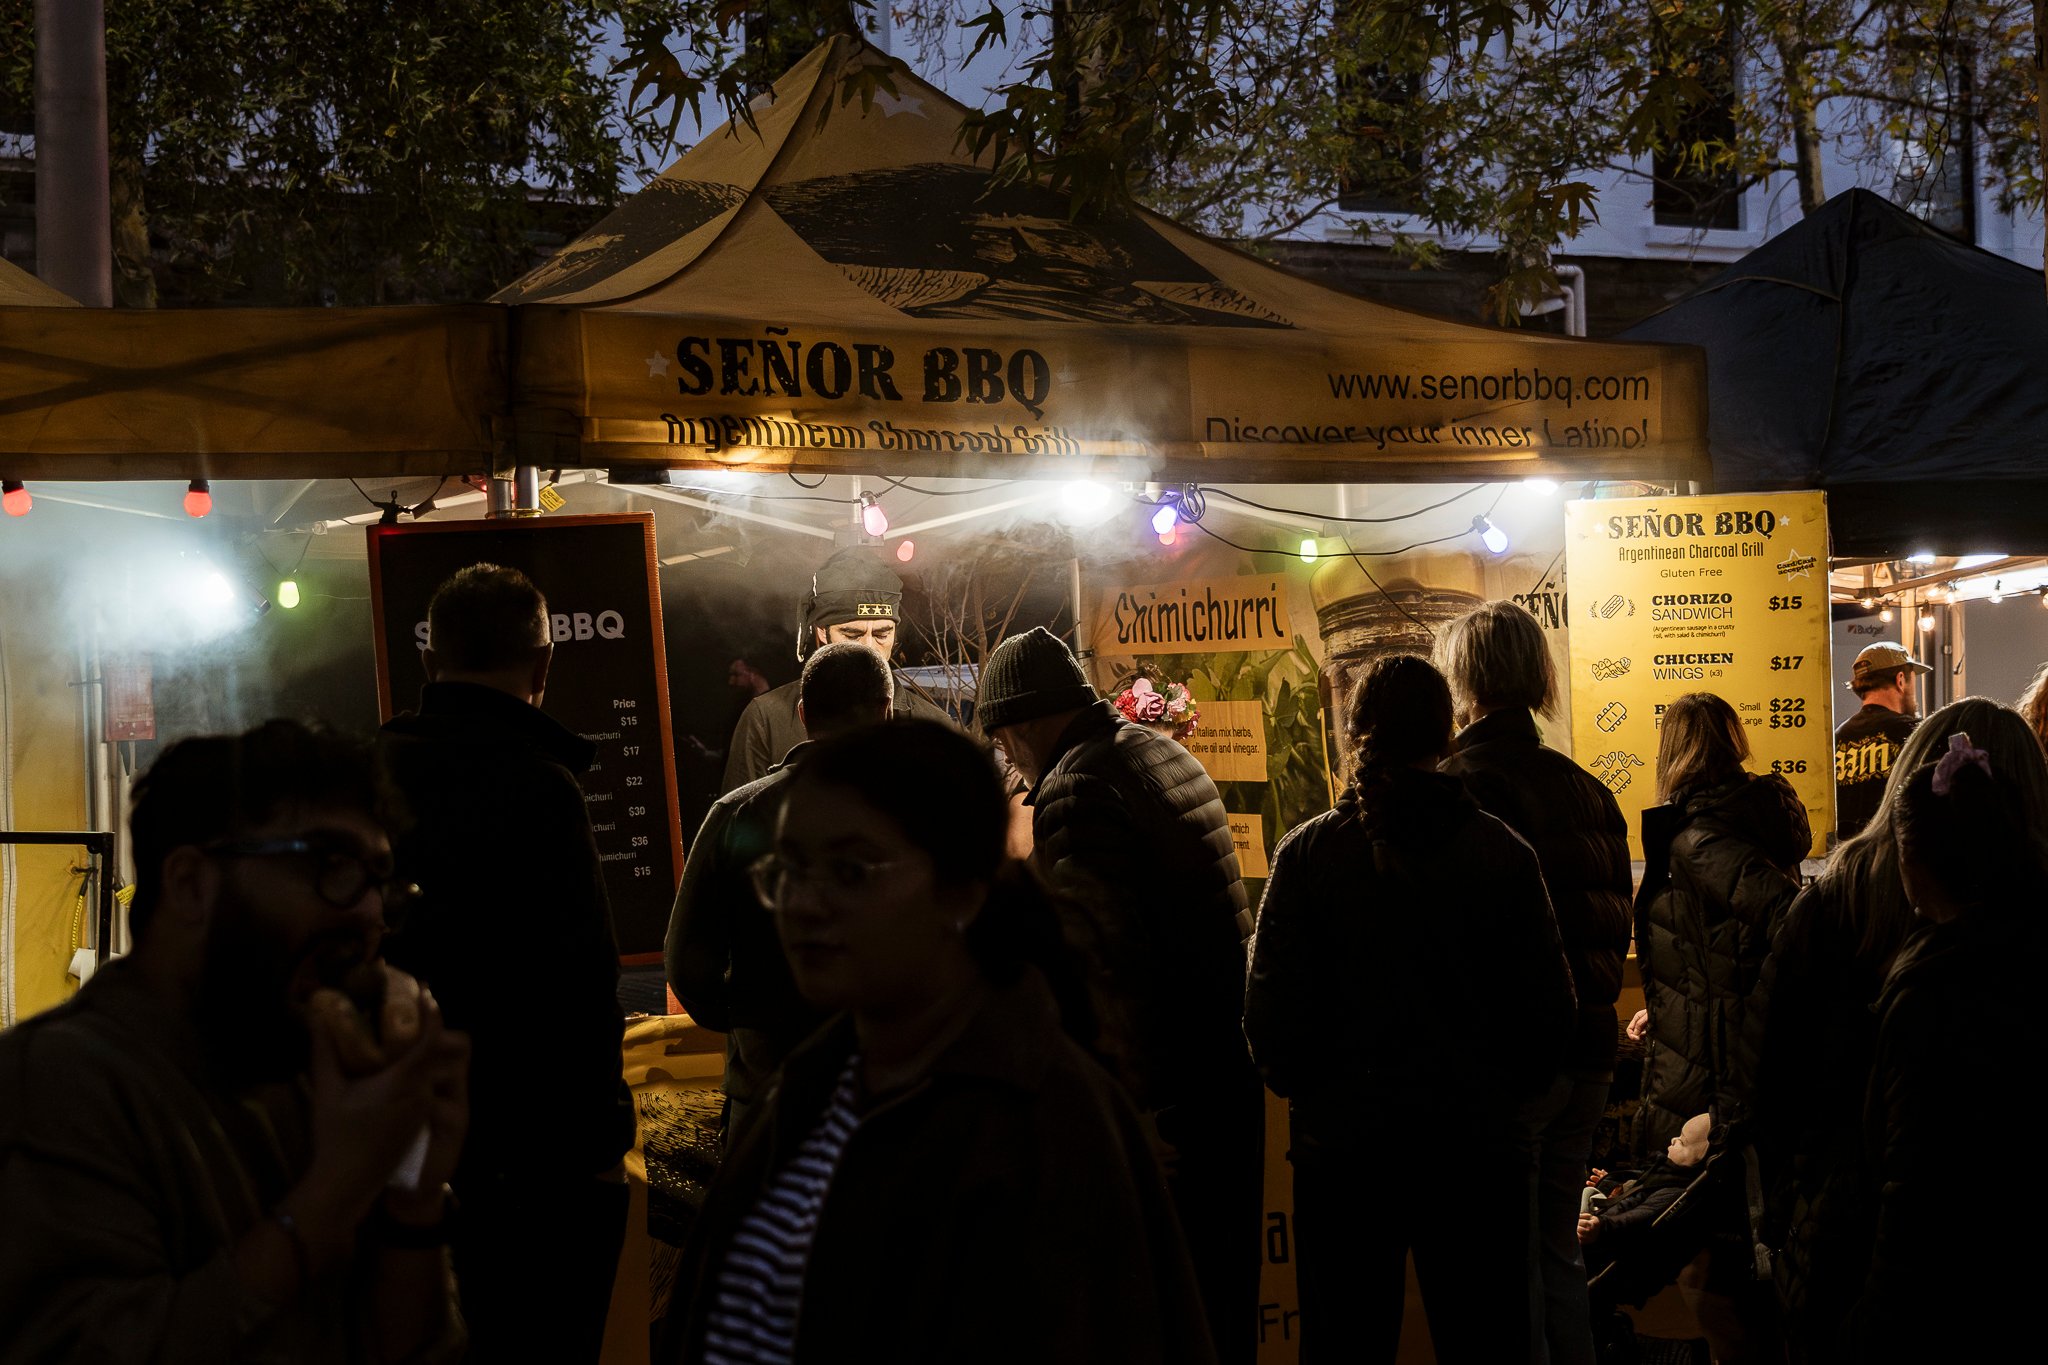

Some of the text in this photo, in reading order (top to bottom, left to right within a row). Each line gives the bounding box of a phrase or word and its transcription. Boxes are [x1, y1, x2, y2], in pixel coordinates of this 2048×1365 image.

[676, 326, 1051, 420] SEÑOR BBQ
[1328, 367, 1650, 409] www.senorbbq.com
[660, 413, 866, 453] Argentinean
[868, 420, 1012, 452] Charcoal
[1206, 416, 1648, 451] Discover your inner Latino!
[1608, 508, 1776, 540] SEÑOR BBQ
[1618, 541, 1764, 564] Argentinean Charcoal Grill
[1660, 567, 1723, 578] Gluten Free
[1651, 592, 1733, 606] CHORIZO
[1768, 595, 1803, 612] $15
[1114, 582, 1285, 644] Chimichurri
[1651, 606, 1733, 621] SANDWICH
[551, 609, 626, 643] BBQ
[1652, 625, 1686, 633] (Argentinean
[1676, 631, 1690, 639] salad
[1653, 653, 1734, 665] CHICKEN
[1770, 655, 1805, 671] $17
[1653, 667, 1723, 680] WINGS (x3)
[613, 699, 636, 709] Price
[1739, 698, 1806, 713] Small $22
[620, 715, 638, 727] $15
[1768, 714, 1807, 730] $30
[1196, 726, 1217, 738] Italian
[1218, 727, 1231, 738] mix
[1232, 726, 1253, 739] herbs,
[623, 746, 640, 757] $17
[1192, 743, 1209, 754] olive
[1209, 742, 1217, 753] oil
[1218, 742, 1231, 753] and
[1233, 742, 1260, 756] vinegar.
[1770, 759, 1807, 775] $36
[626, 775, 643, 787] $22
[628, 806, 646, 817] $30
[1230, 822, 1250, 834] which
[631, 835, 649, 847] $36
[634, 865, 652, 877] $15
